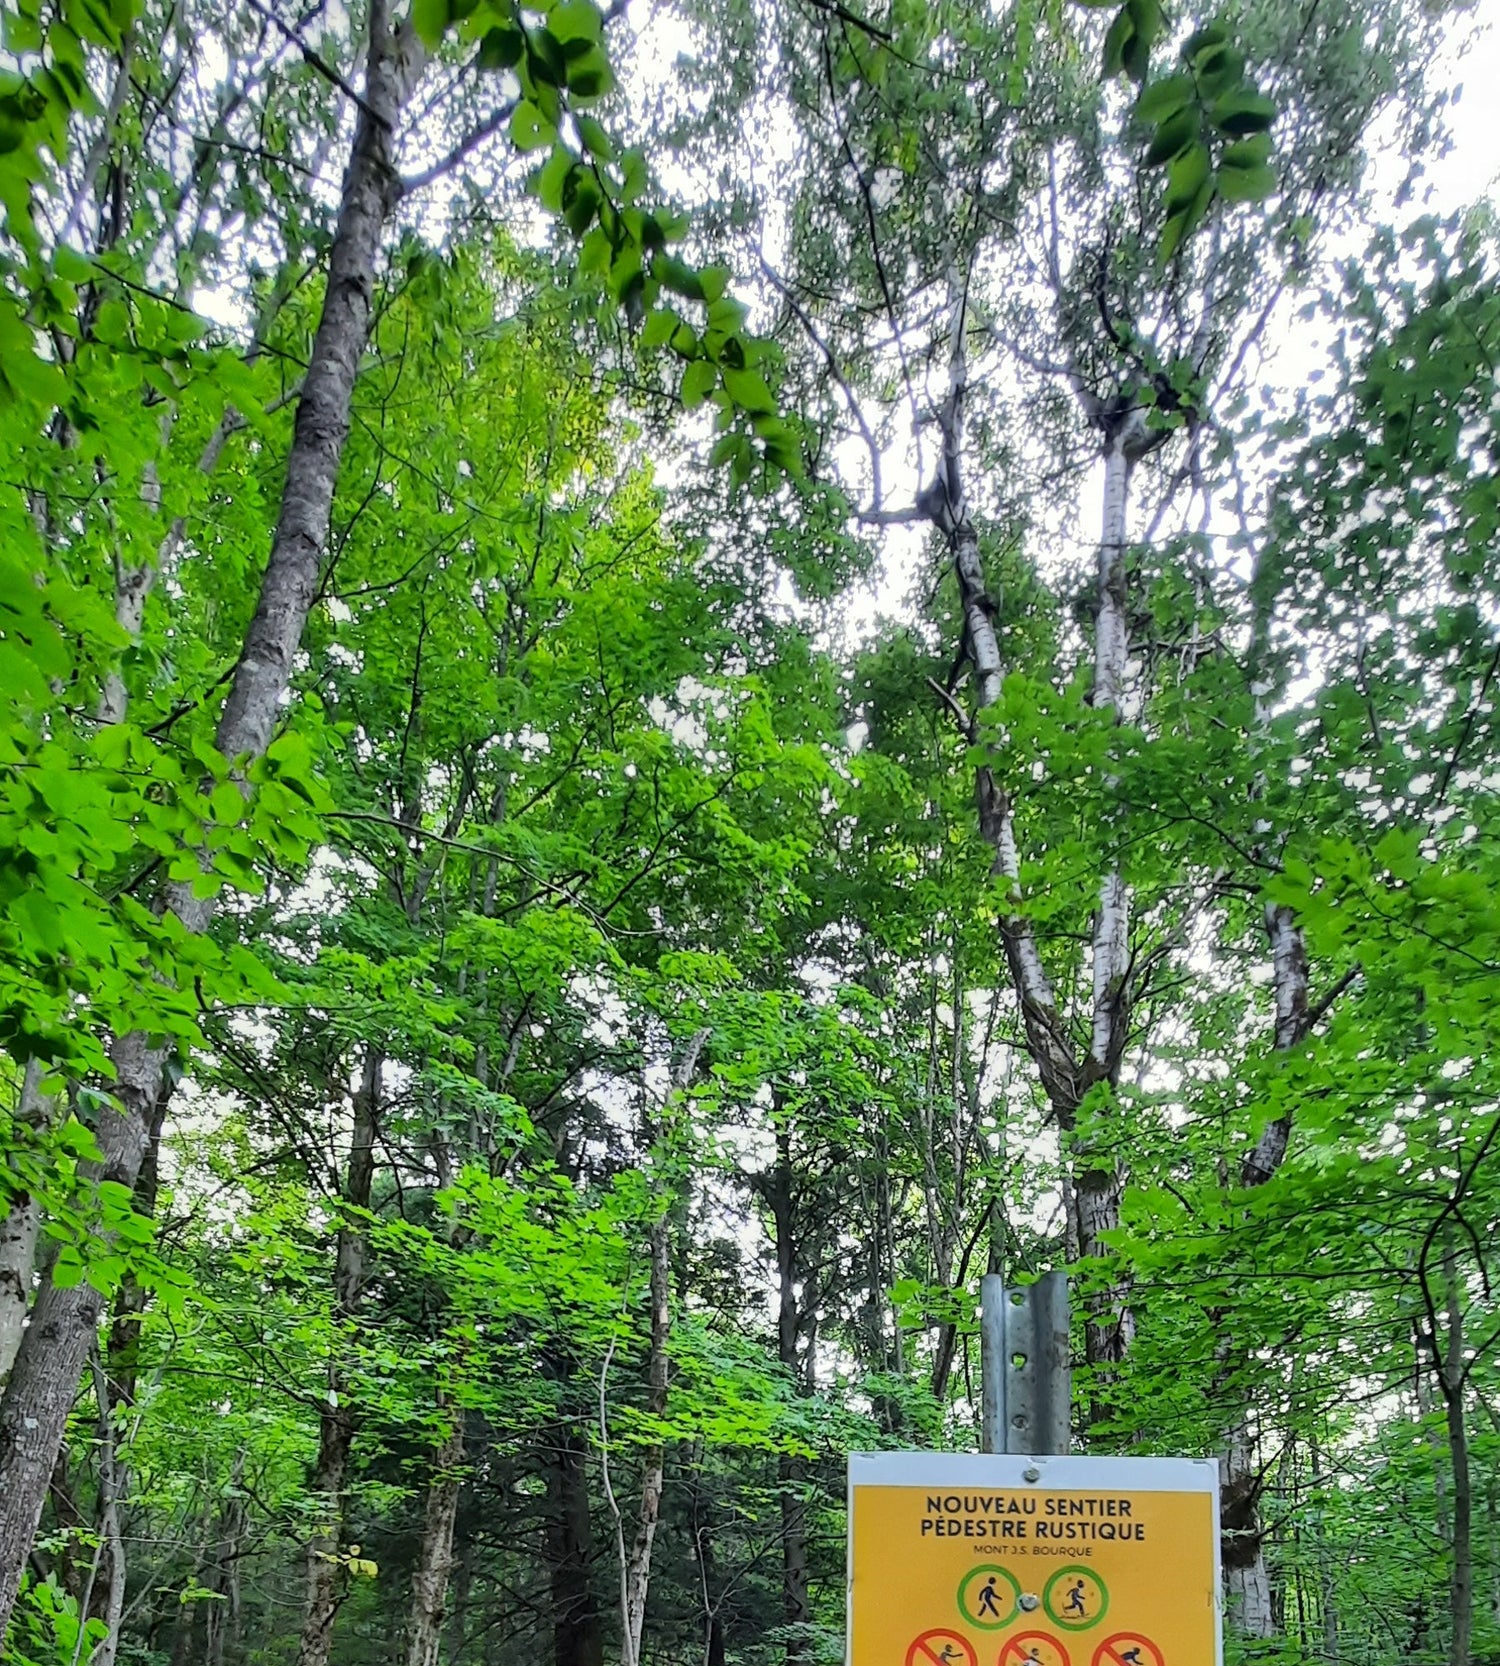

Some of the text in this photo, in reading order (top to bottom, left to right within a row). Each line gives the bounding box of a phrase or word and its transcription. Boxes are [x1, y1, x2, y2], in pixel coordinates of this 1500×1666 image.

[926, 1496, 1132, 1517] NOUVEAU SENTIER
[921, 1516, 1145, 1541] PÉDESTRE RUSTIQUE
[974, 1545, 1009, 1555] MONT
[1033, 1546, 1092, 1557] BOURQUE
